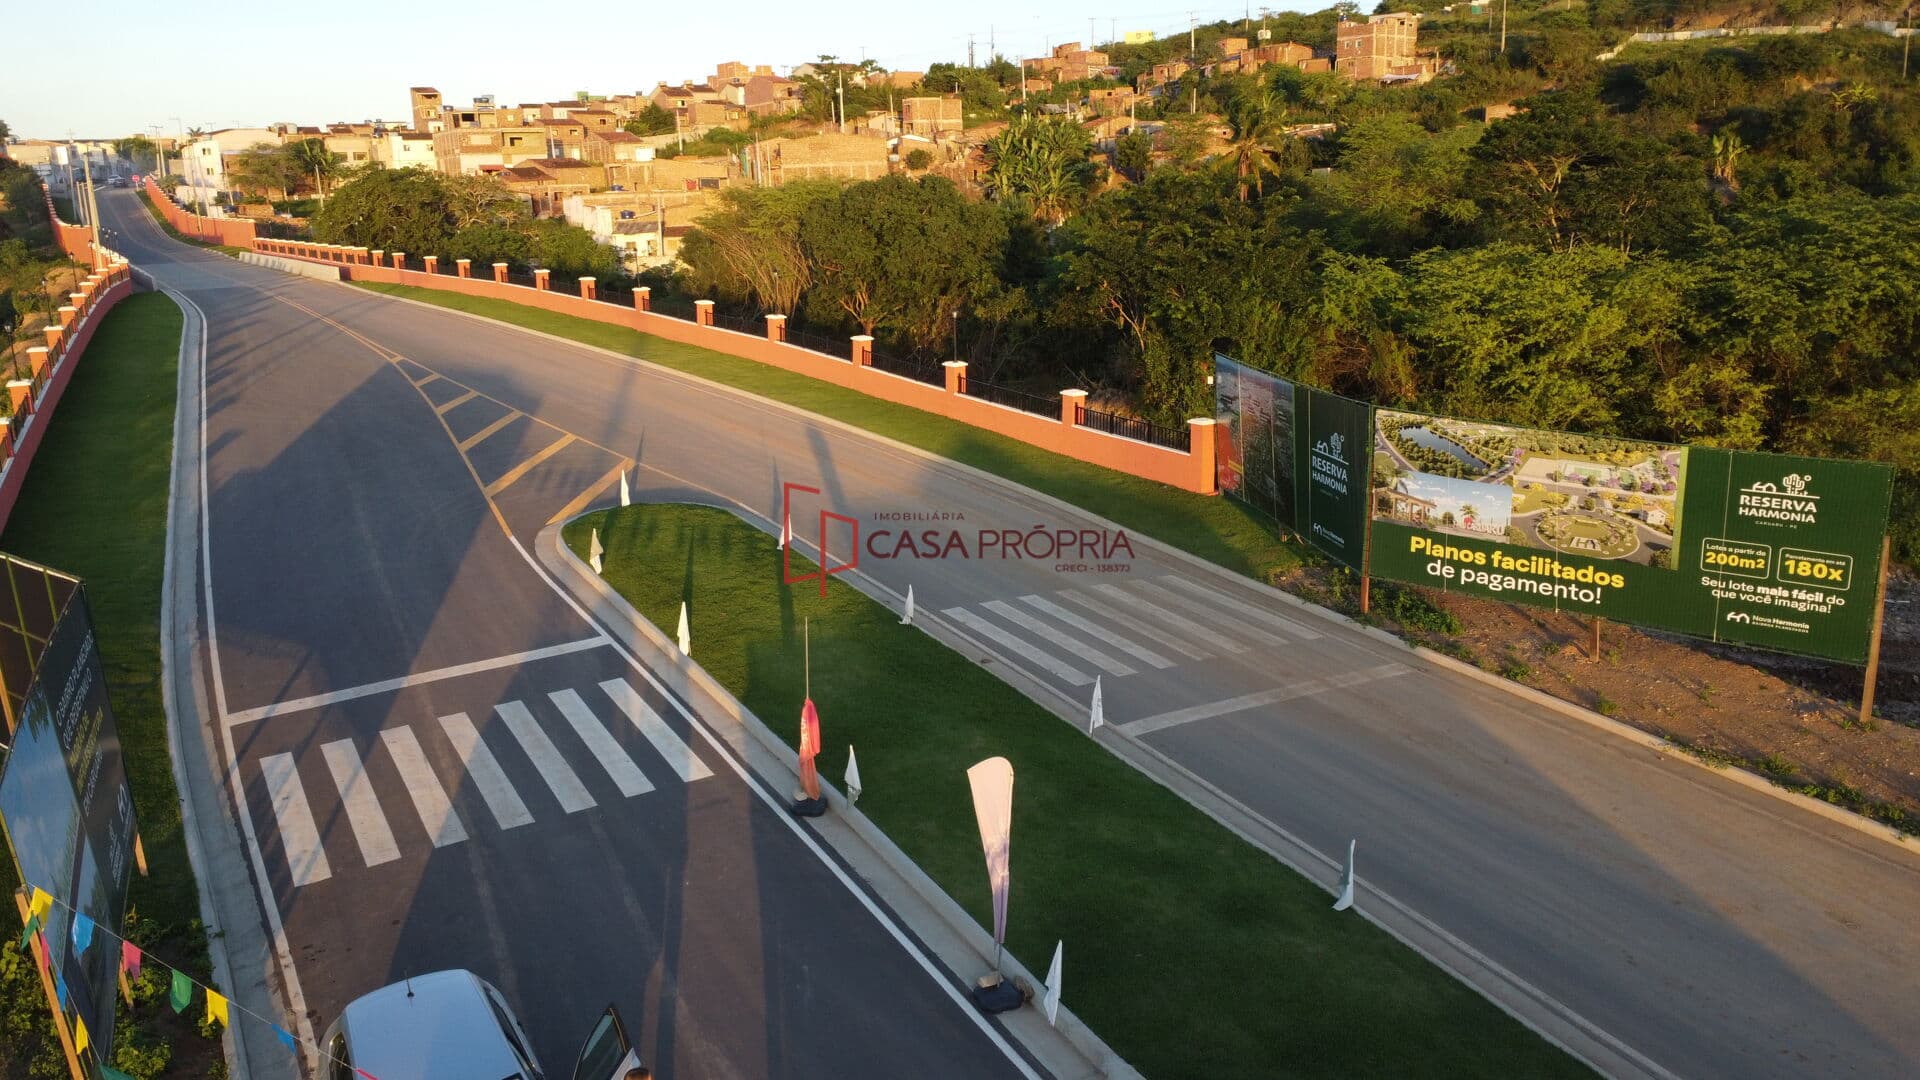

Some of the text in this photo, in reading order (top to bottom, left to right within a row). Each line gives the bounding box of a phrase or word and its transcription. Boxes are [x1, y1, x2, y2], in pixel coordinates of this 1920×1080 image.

[1312, 455, 1348, 482] RESERVA
[1312, 469, 1347, 496] HARMONIA
[1738, 506, 1816, 524] HARMONIA
[1740, 494, 1817, 513] RESERVA
[1704, 551, 1766, 569] 200m2
[1706, 543, 1727, 552] Lotes
[1734, 547, 1756, 555] partir
[1409, 535, 1626, 589] Planos facilitados
[1784, 559, 1844, 582] 180x
[1426, 559, 1602, 605] de pagamento!
[1701, 576, 1846, 606] Seu lote mais fácil do
[1711, 588, 1832, 614] que você imagina!
[1752, 614, 1810, 630] Nova Harmonia
